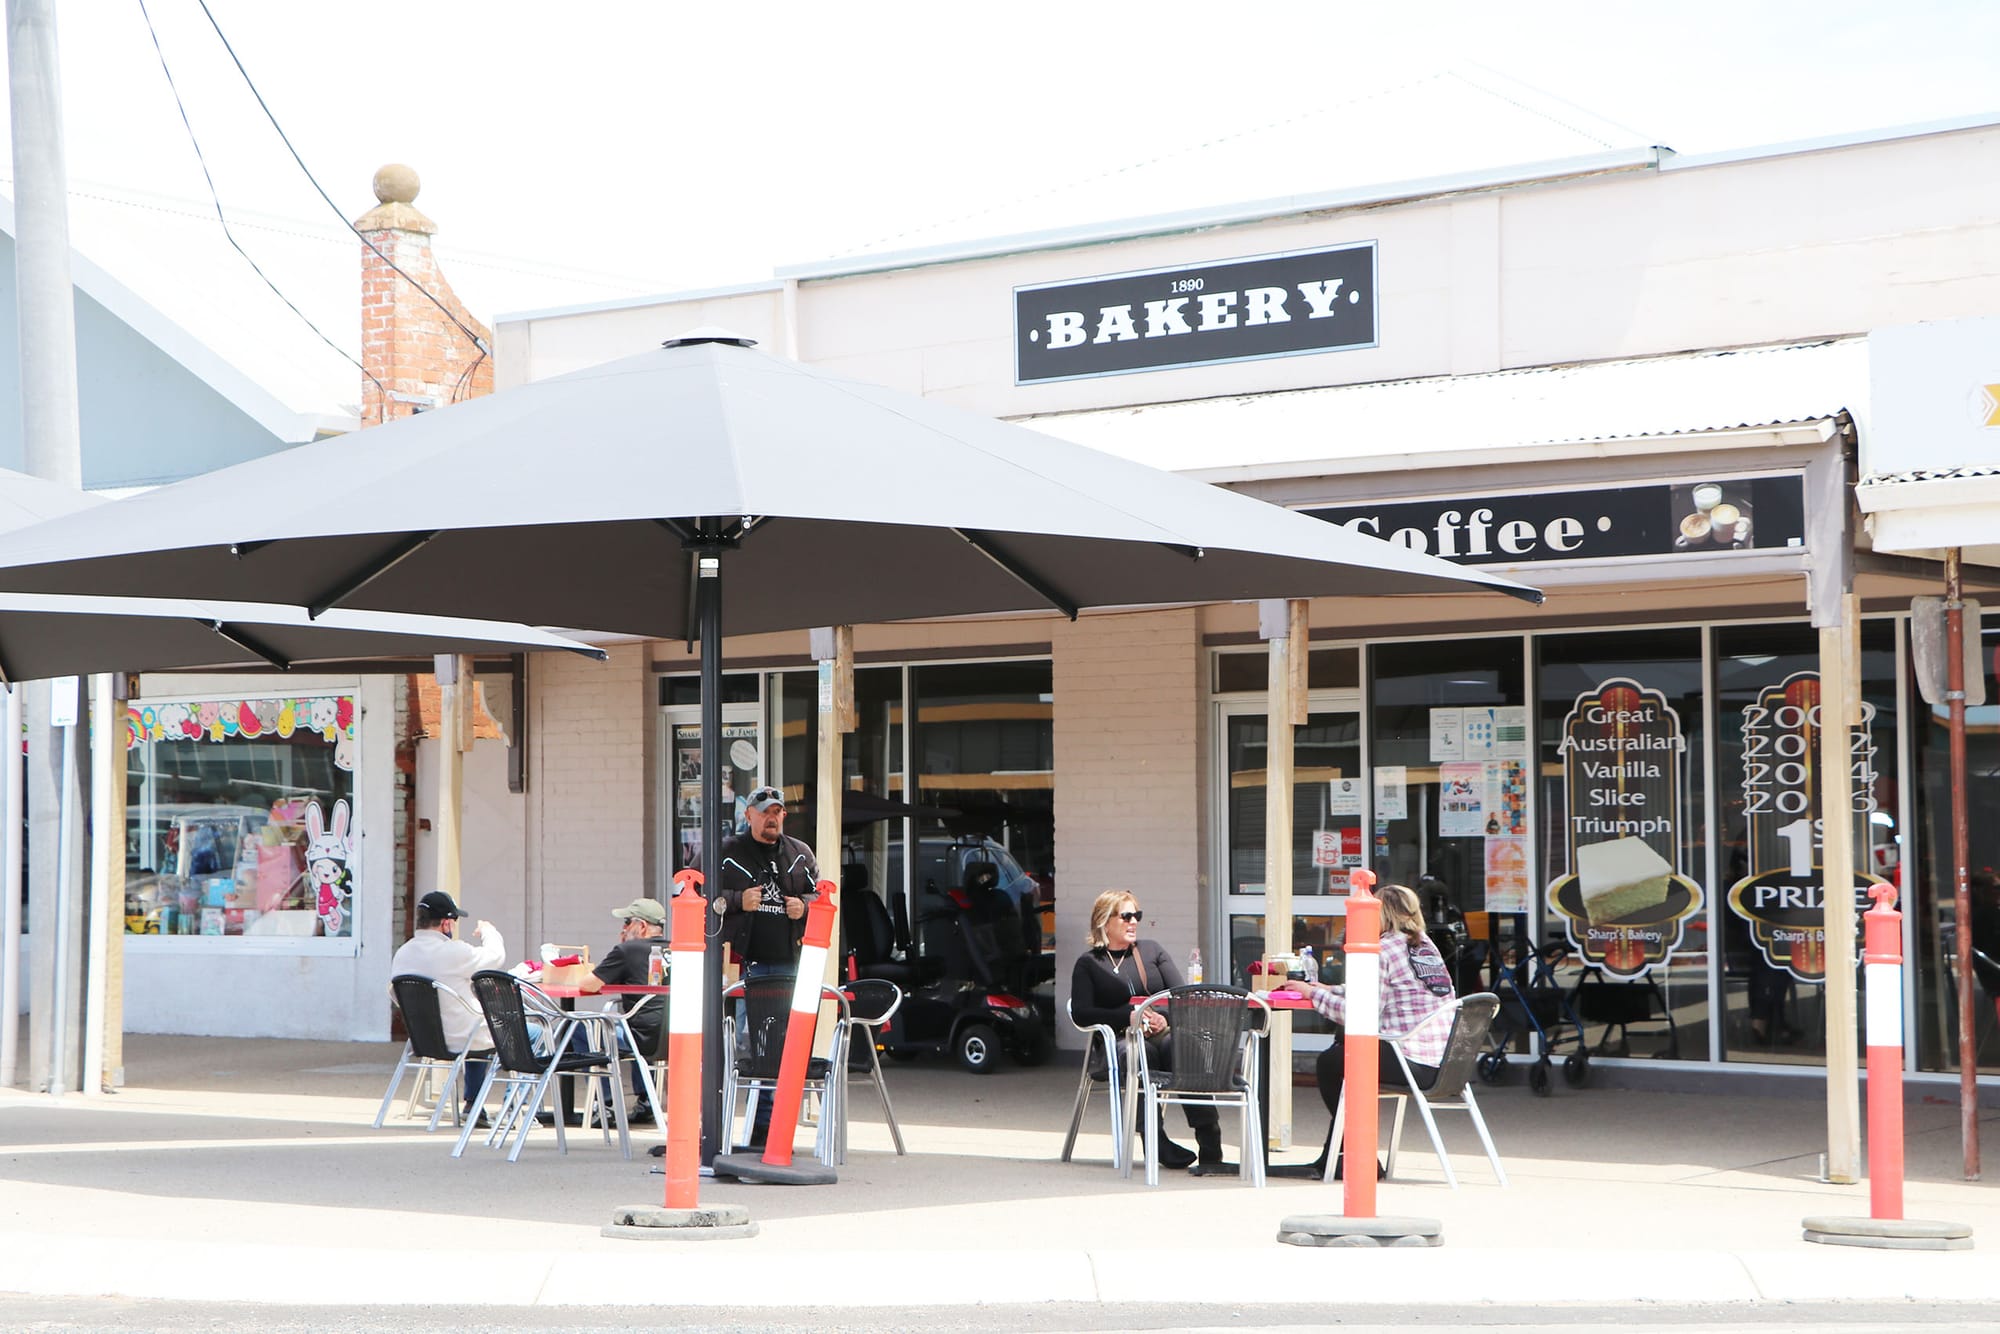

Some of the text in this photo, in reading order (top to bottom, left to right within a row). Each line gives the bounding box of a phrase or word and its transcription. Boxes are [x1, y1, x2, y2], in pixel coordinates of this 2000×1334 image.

[1171, 278, 1204, 293] 1890
[1046, 278, 1344, 350] BAKERY
[1587, 706, 1654, 724] Great
[1562, 733, 1685, 752] Australian
[1745, 732, 1873, 757] 202
[1582, 761, 1661, 779] Vanilla
[1745, 761, 1874, 785] 204
[1590, 788, 1646, 806] Slice
[1746, 790, 1876, 813] 206
[1571, 816, 1672, 838] Triumph
[1342, 855, 1362, 863] PUSH
[1754, 886, 1872, 908] PRIE
[1587, 928, 1662, 944] Sharp's Bakery
[1772, 929, 1815, 944] Sharp's
